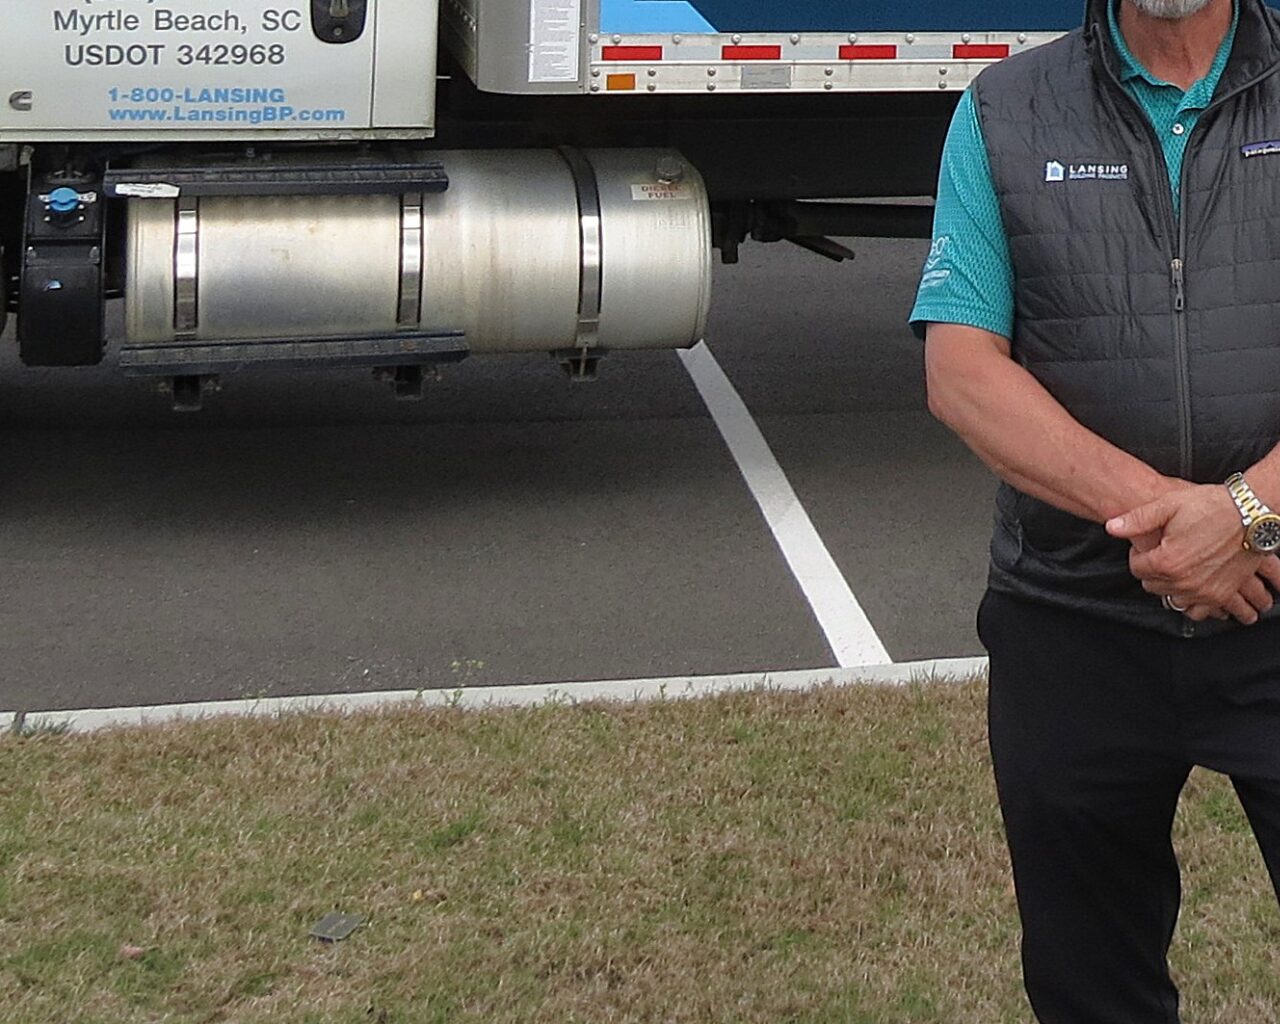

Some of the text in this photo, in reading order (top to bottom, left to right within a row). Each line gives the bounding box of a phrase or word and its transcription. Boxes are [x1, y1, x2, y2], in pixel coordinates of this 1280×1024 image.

[53, 9, 301, 36] Myrtle Beach, SC
[64, 44, 286, 66] USDOT 342968
[108, 88, 286, 103] 1-800-LANSING
[108, 106, 346, 124] www.LansingBP.com
[1069, 164, 1128, 174] LANSING
